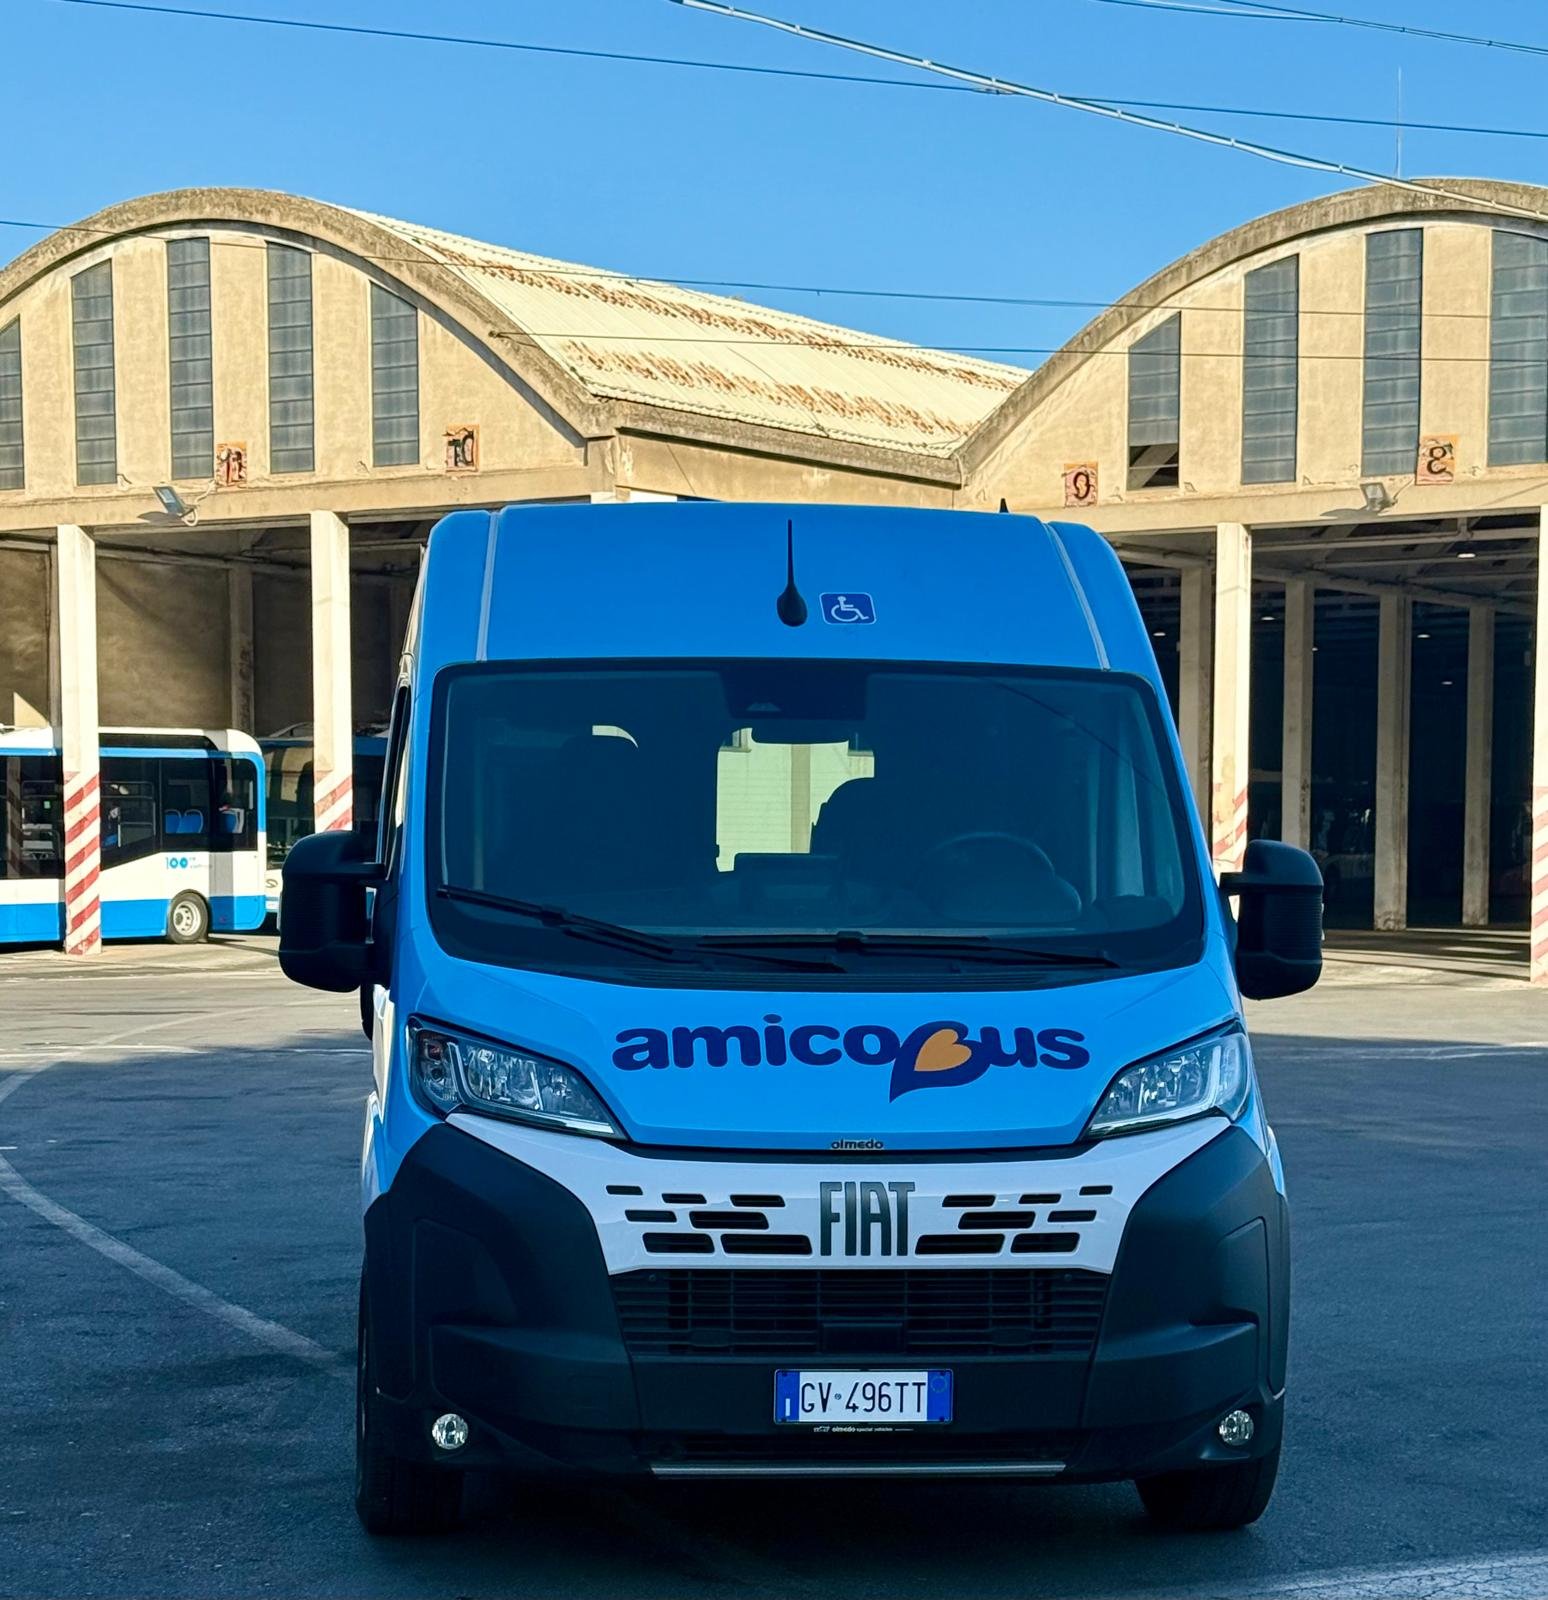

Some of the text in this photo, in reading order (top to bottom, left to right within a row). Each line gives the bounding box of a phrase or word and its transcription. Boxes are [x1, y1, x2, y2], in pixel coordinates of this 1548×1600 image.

[831, 1138, 884, 1150] olmedo
[820, 1181, 916, 1257] FIAT
[801, 1382, 927, 1413] GV 496TT
